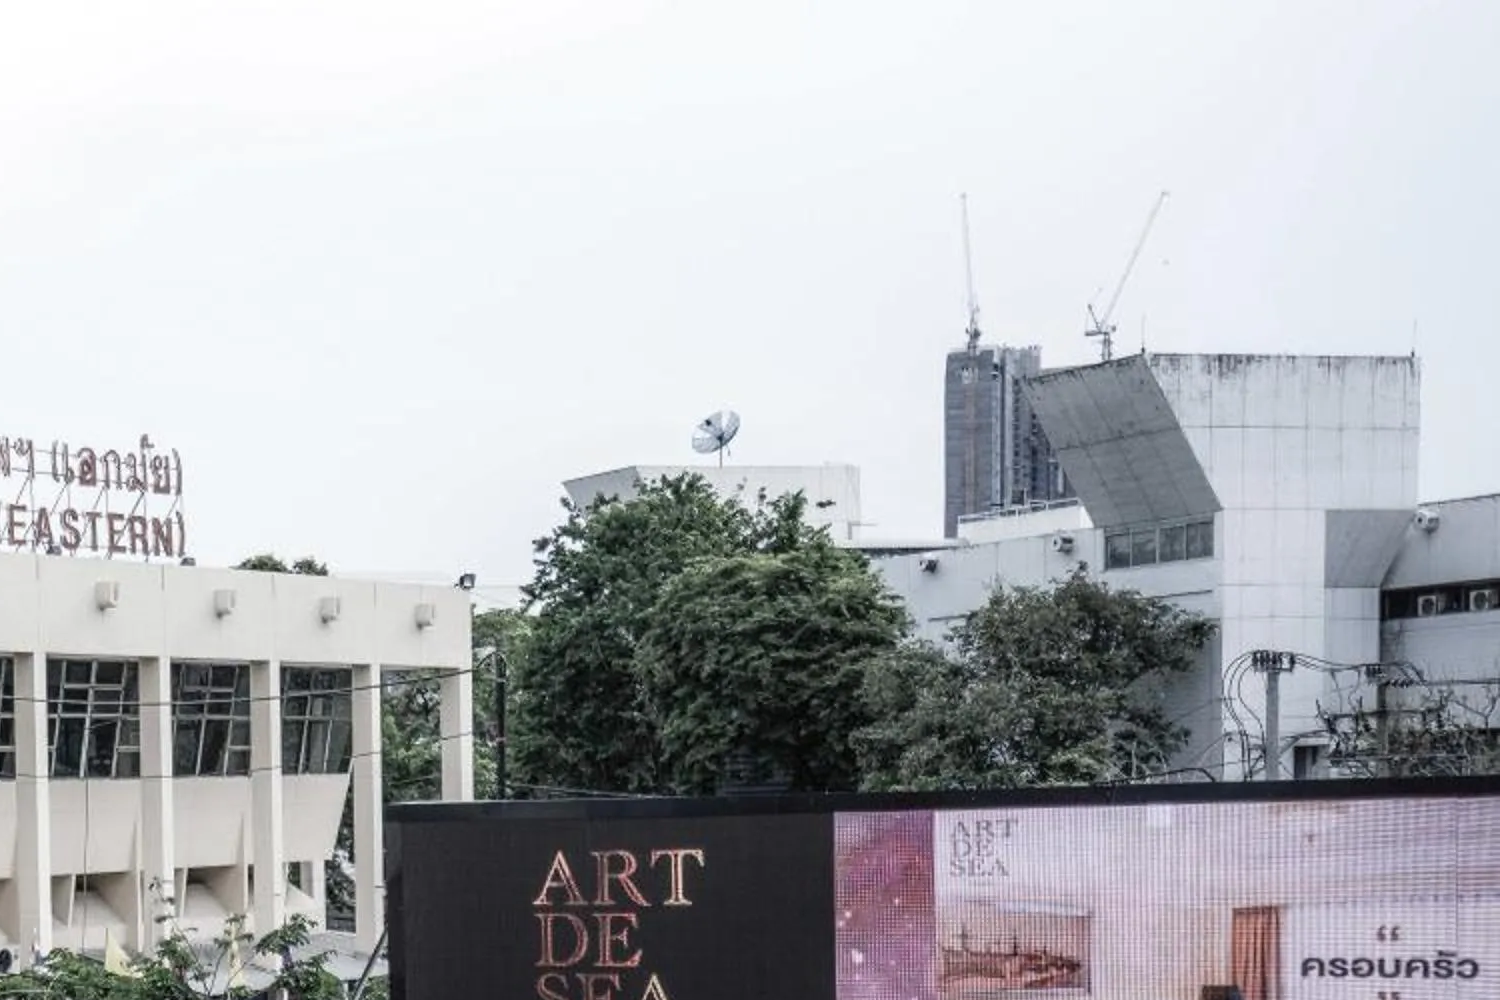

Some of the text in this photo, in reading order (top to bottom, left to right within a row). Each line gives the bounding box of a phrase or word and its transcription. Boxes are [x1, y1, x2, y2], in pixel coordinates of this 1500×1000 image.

[532, 849, 705, 907] ART
[534, 912, 643, 968] DE
[1301, 950, 1480, 979] ครอบครัว
